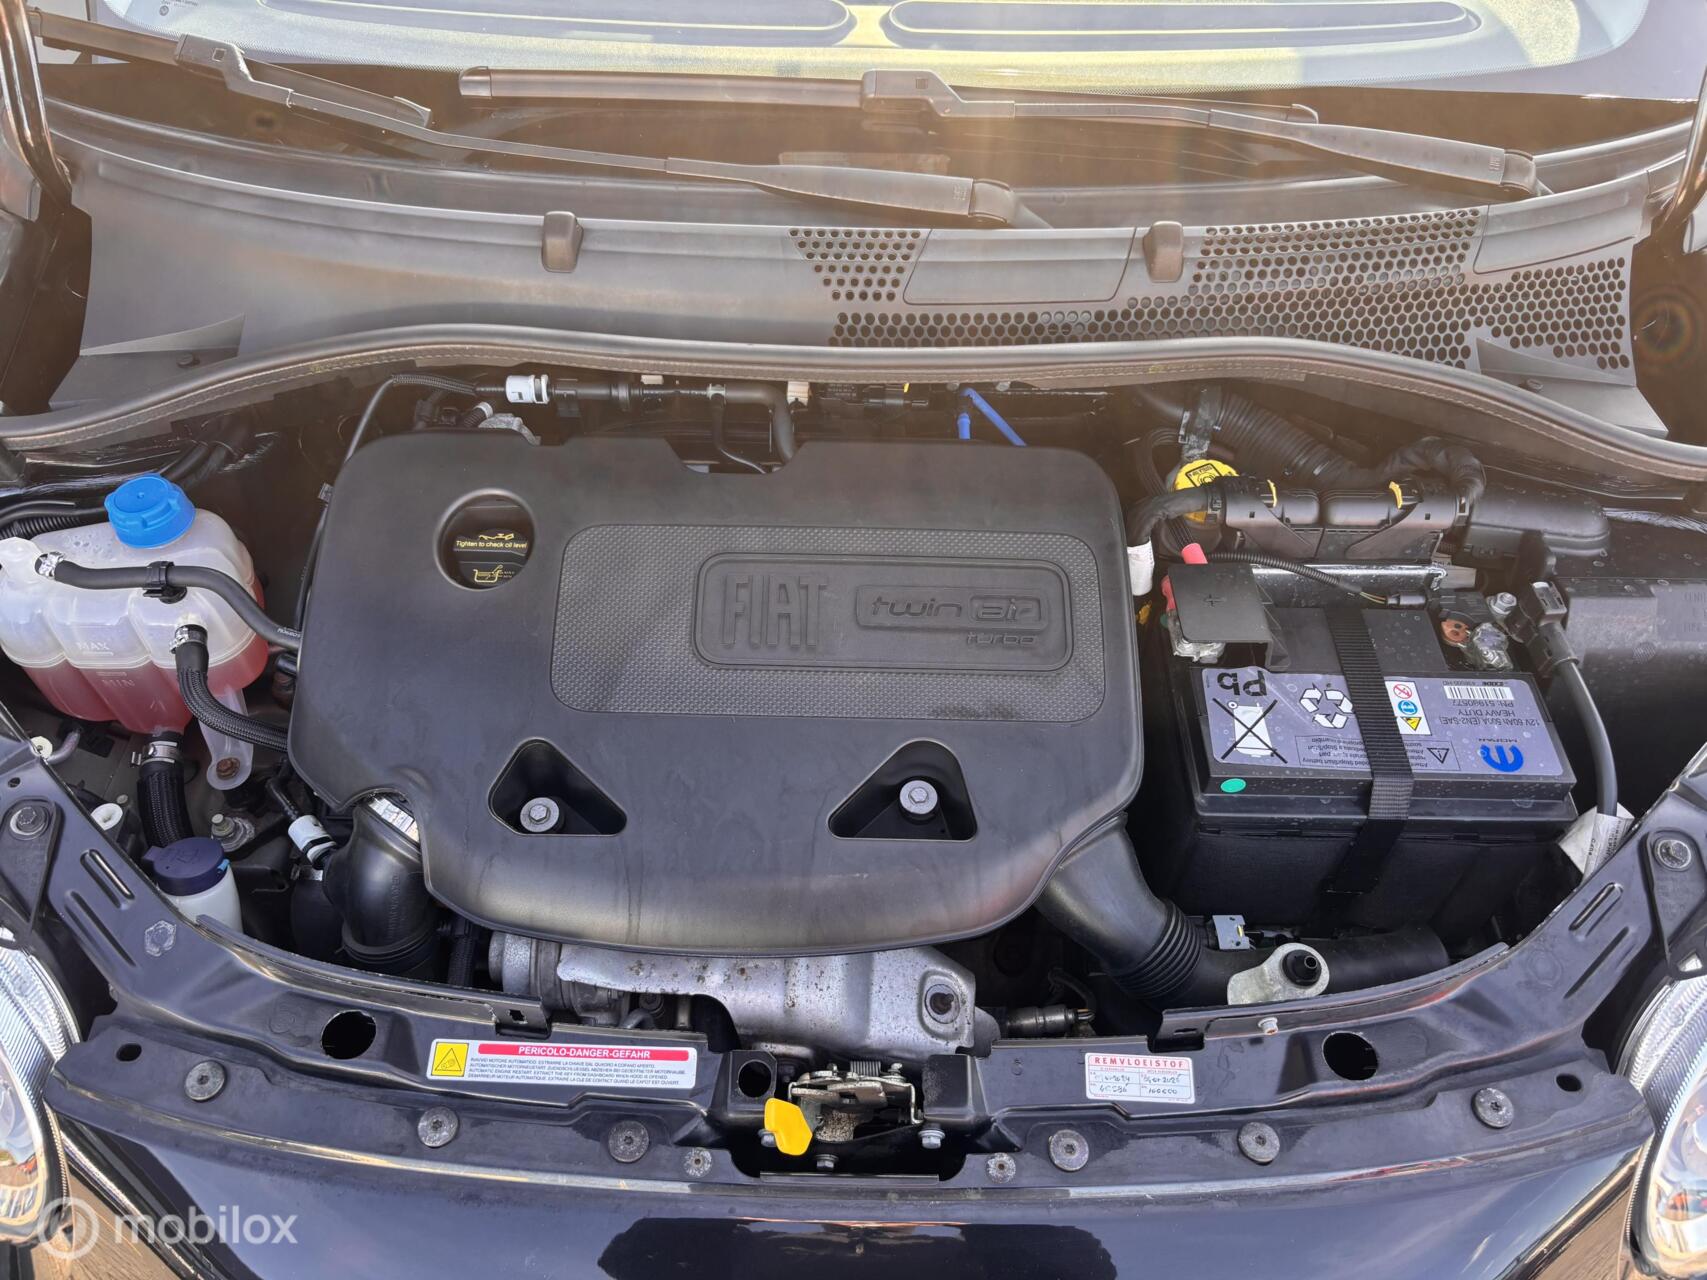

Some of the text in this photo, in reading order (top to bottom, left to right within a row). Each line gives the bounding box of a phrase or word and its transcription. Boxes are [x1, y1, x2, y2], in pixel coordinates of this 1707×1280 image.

[456, 540, 477, 548] Tighten
[720, 574, 826, 650] FIAT
[872, 595, 963, 618] twin
[966, 632, 1038, 646] turbo
[76, 641, 110, 651] MAX
[102, 679, 136, 688] MIN
[1217, 671, 1268, 697] Pb
[1458, 708, 1516, 718] HEAVY DUTY
[1525, 718, 1540, 726] 12V
[518, 1046, 651, 1059] PERICOLO-DANGER-GEFAHR
[1095, 1057, 1183, 1068] REMVLOEISTOF
